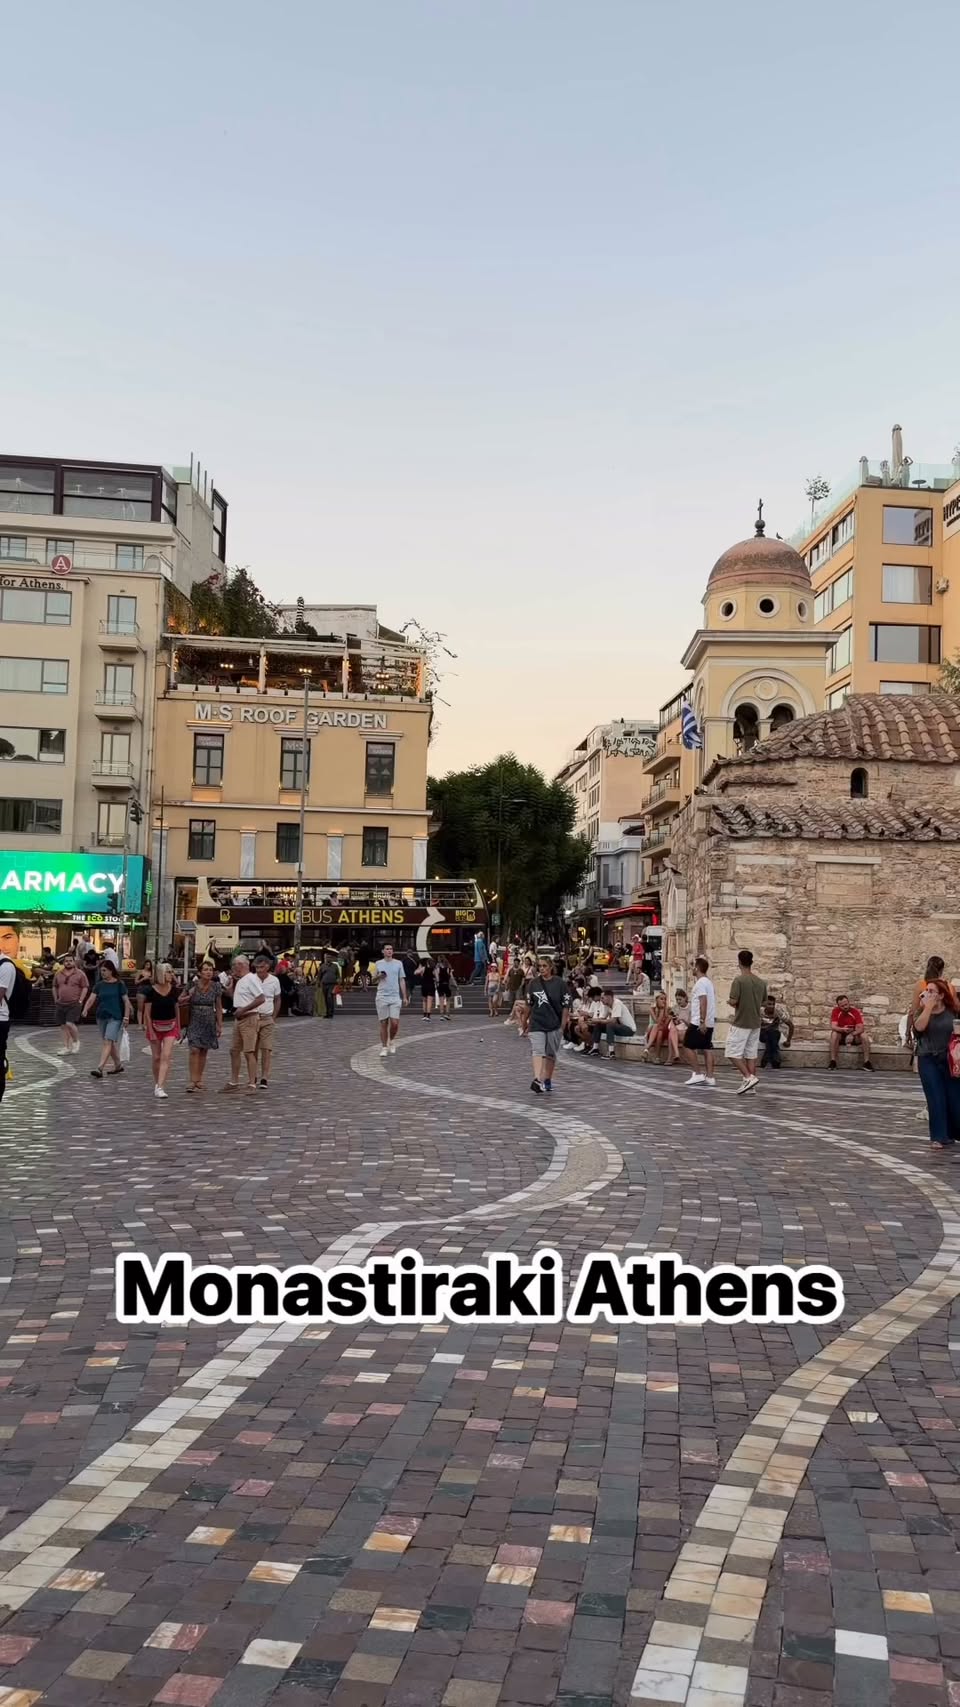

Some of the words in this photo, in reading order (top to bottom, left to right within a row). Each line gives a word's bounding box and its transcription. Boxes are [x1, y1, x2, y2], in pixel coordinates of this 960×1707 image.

[54, 556, 68, 570] A
[19, 577, 64, 590] Athens.
[240, 707, 297, 725] ROOF
[306, 710, 387, 729] GARDEN
[1, 870, 125, 893] ARMACY
[338, 909, 404, 923] ATHENS
